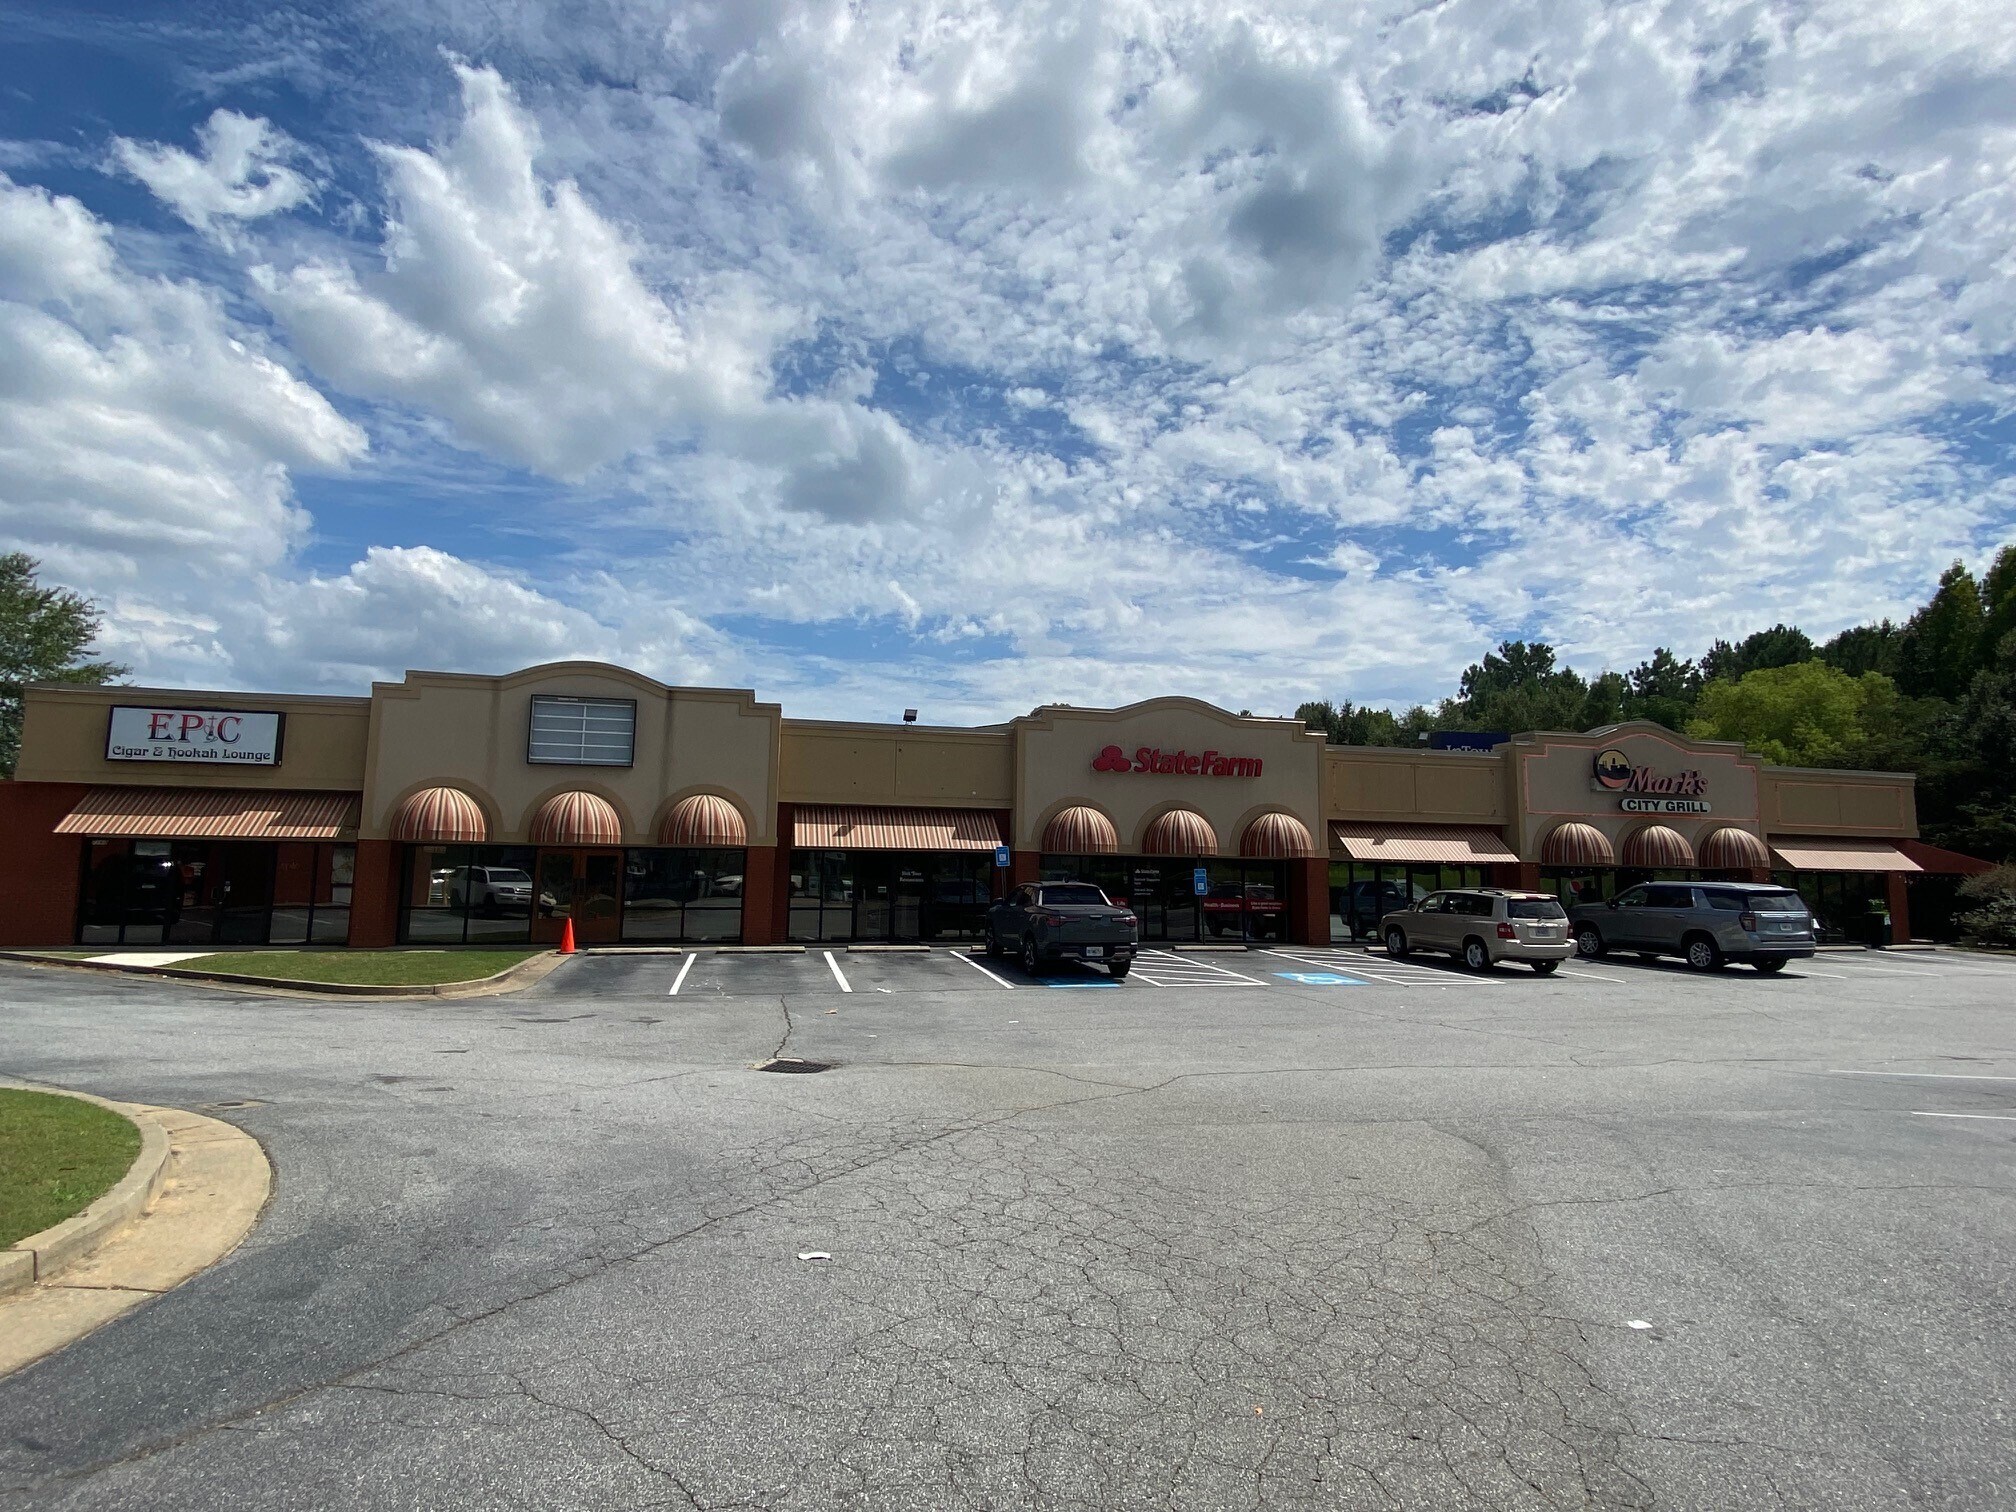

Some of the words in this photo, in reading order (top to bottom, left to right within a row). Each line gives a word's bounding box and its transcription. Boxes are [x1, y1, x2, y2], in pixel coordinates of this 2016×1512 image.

[112, 745, 149, 758] Cigar
[153, 747, 163, 757] &
[222, 749, 271, 762] Lounge
[1626, 766, 1708, 795] Mark's
[1626, 799, 1660, 811] CITY
[1665, 801, 1708, 813] GRILL
